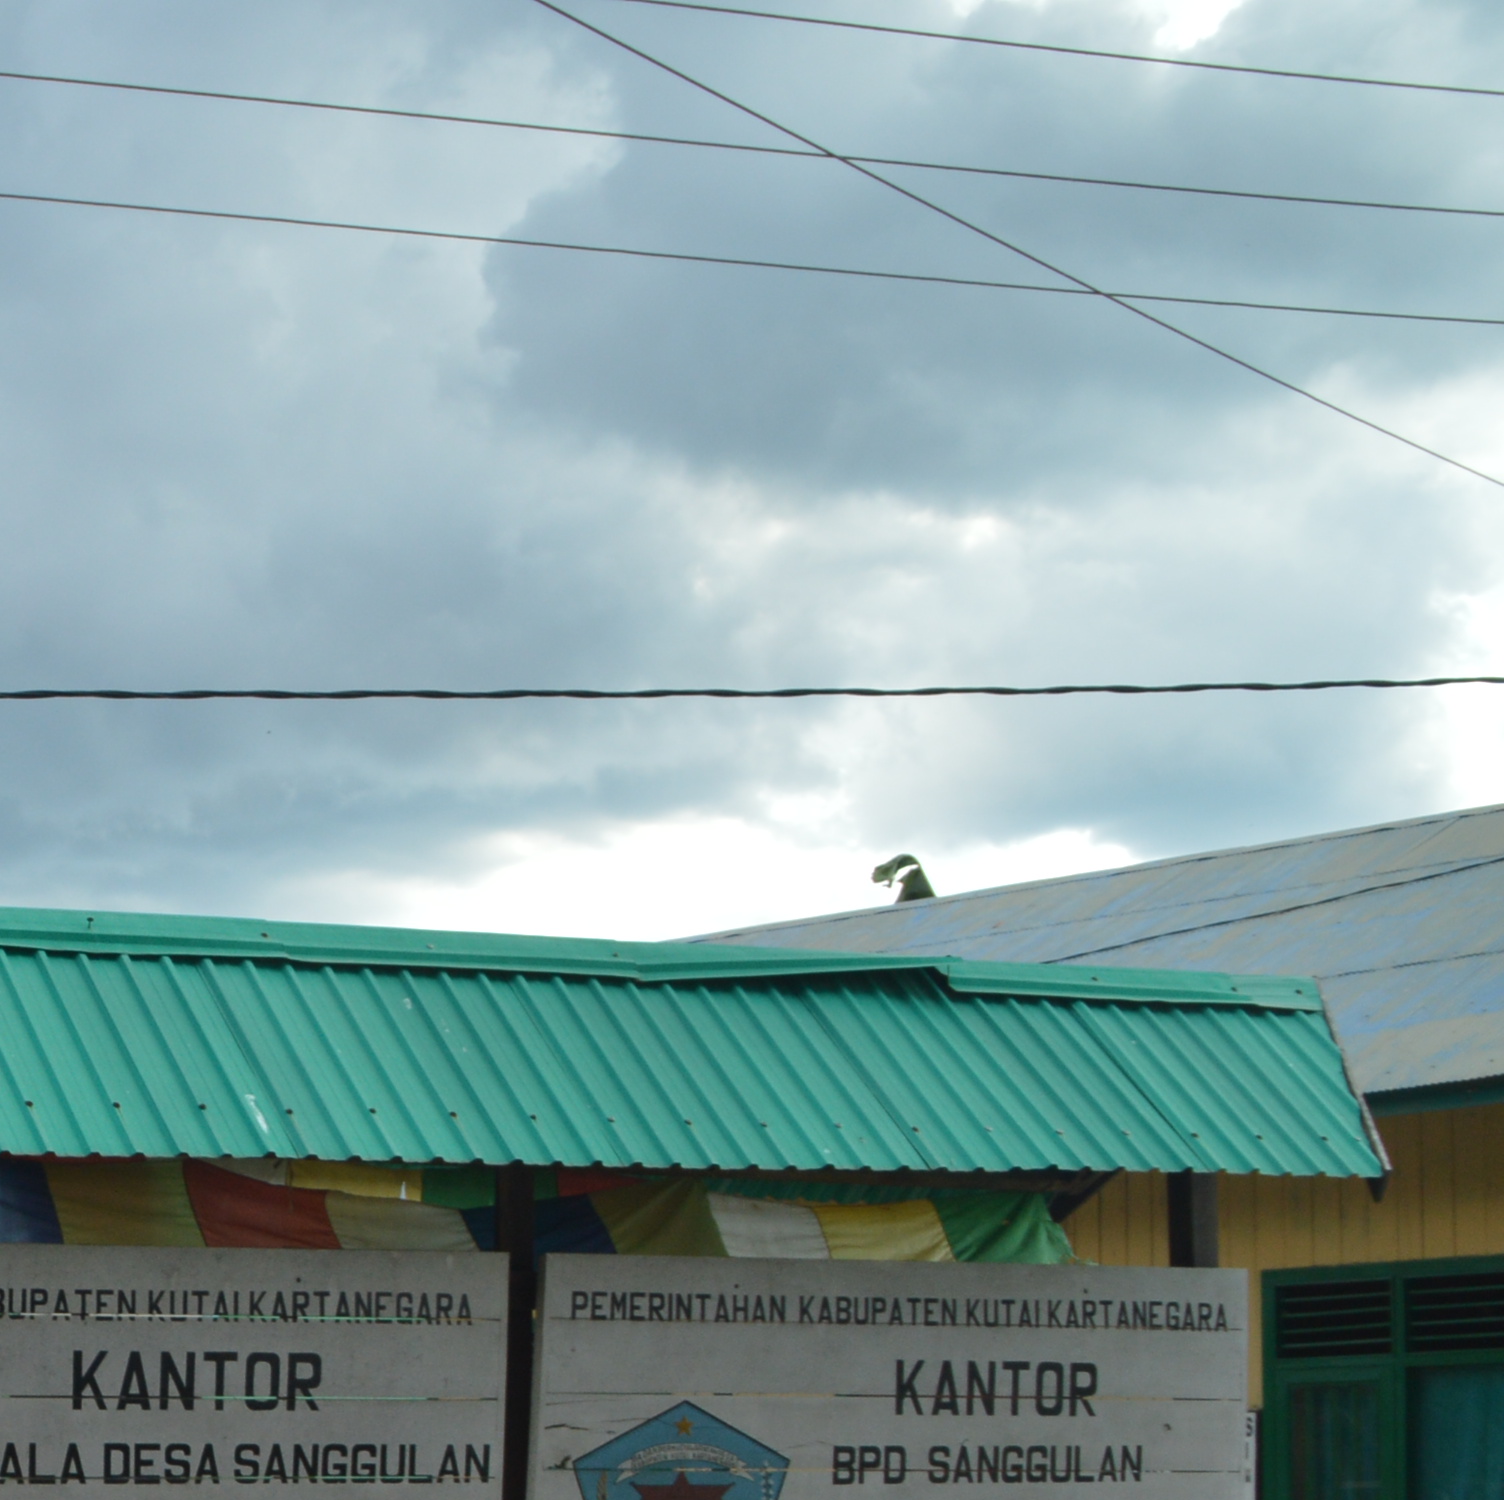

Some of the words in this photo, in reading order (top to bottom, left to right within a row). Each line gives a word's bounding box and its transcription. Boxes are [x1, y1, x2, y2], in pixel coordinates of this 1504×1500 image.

[147, 1289, 241, 1323] KUTAI
[248, 1289, 474, 1326] KARTANEGARA
[570, 1290, 788, 1324] PEMERINTAHAN
[798, 1294, 959, 1327] KABUPATEN
[966, 1298, 1041, 1329] KUTAI
[1047, 1298, 1229, 1332] KARTANEGARA
[71, 1350, 323, 1411] KANTOR
[894, 1359, 1099, 1417] KANTOR
[103, 1442, 222, 1486] DESA
[233, 1442, 492, 1486] SANGGULAN
[831, 1445, 908, 1486] BPD
[927, 1445, 1144, 1485] SANGGULAN
